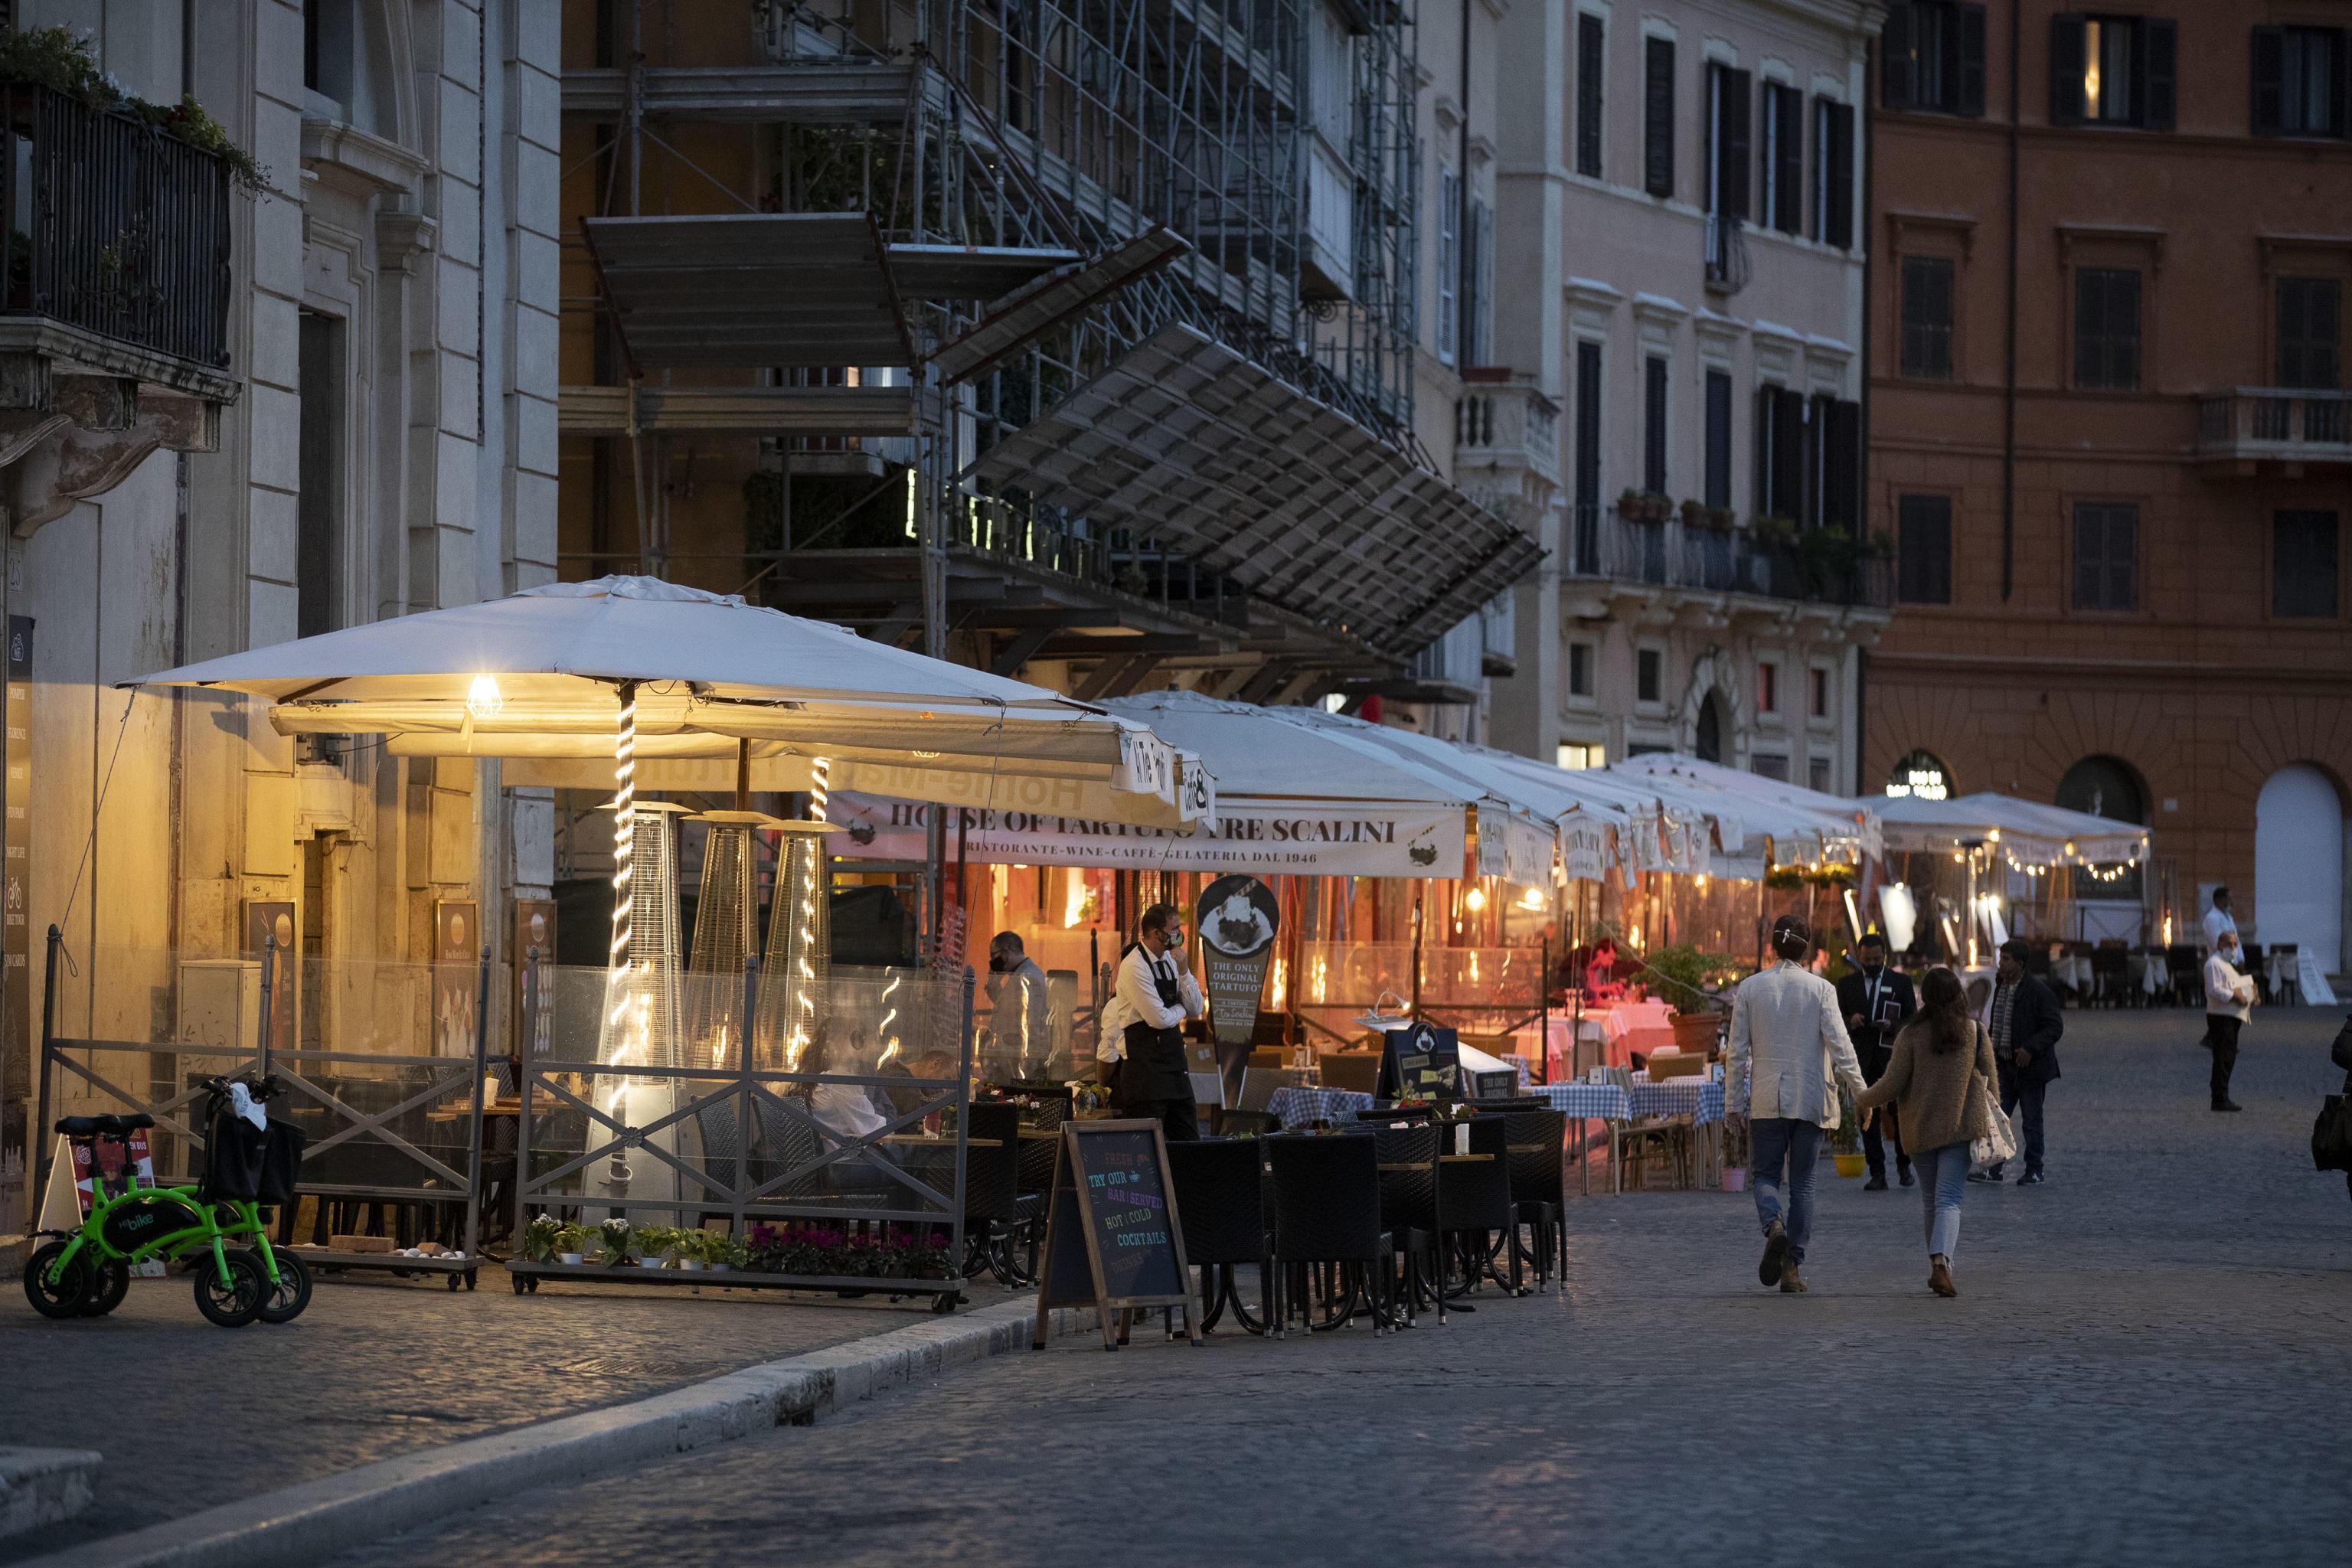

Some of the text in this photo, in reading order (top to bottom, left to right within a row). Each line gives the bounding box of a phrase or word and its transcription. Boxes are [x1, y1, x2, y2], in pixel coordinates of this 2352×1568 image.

[8, 727, 26, 740] FLORENCE
[10, 766, 24, 779] VENICE
[1004, 811, 1044, 833] OF
[1272, 818, 1396, 844] SCALINI
[6, 847, 18, 858] NIGHT
[1253, 851, 1281, 863] DAL
[1285, 853, 1317, 864] 1946
[6, 913, 25, 926] BIKE TOUR
[4, 954, 26, 968] SIM CARDS
[1213, 962, 1259, 973] THE ONLY
[1213, 972, 1258, 983] ORIGINAL
[1210, 981, 1263, 993] "TARTUFO"
[1483, 1076, 1509, 1087] THE ONLY
[1088, 1171, 1128, 1187] TRY OUR
[1107, 1187, 1163, 1209] BAR SERVED
[1105, 1207, 1152, 1230] HOT COLD
[1117, 1230, 1167, 1246] COCKTAILS
